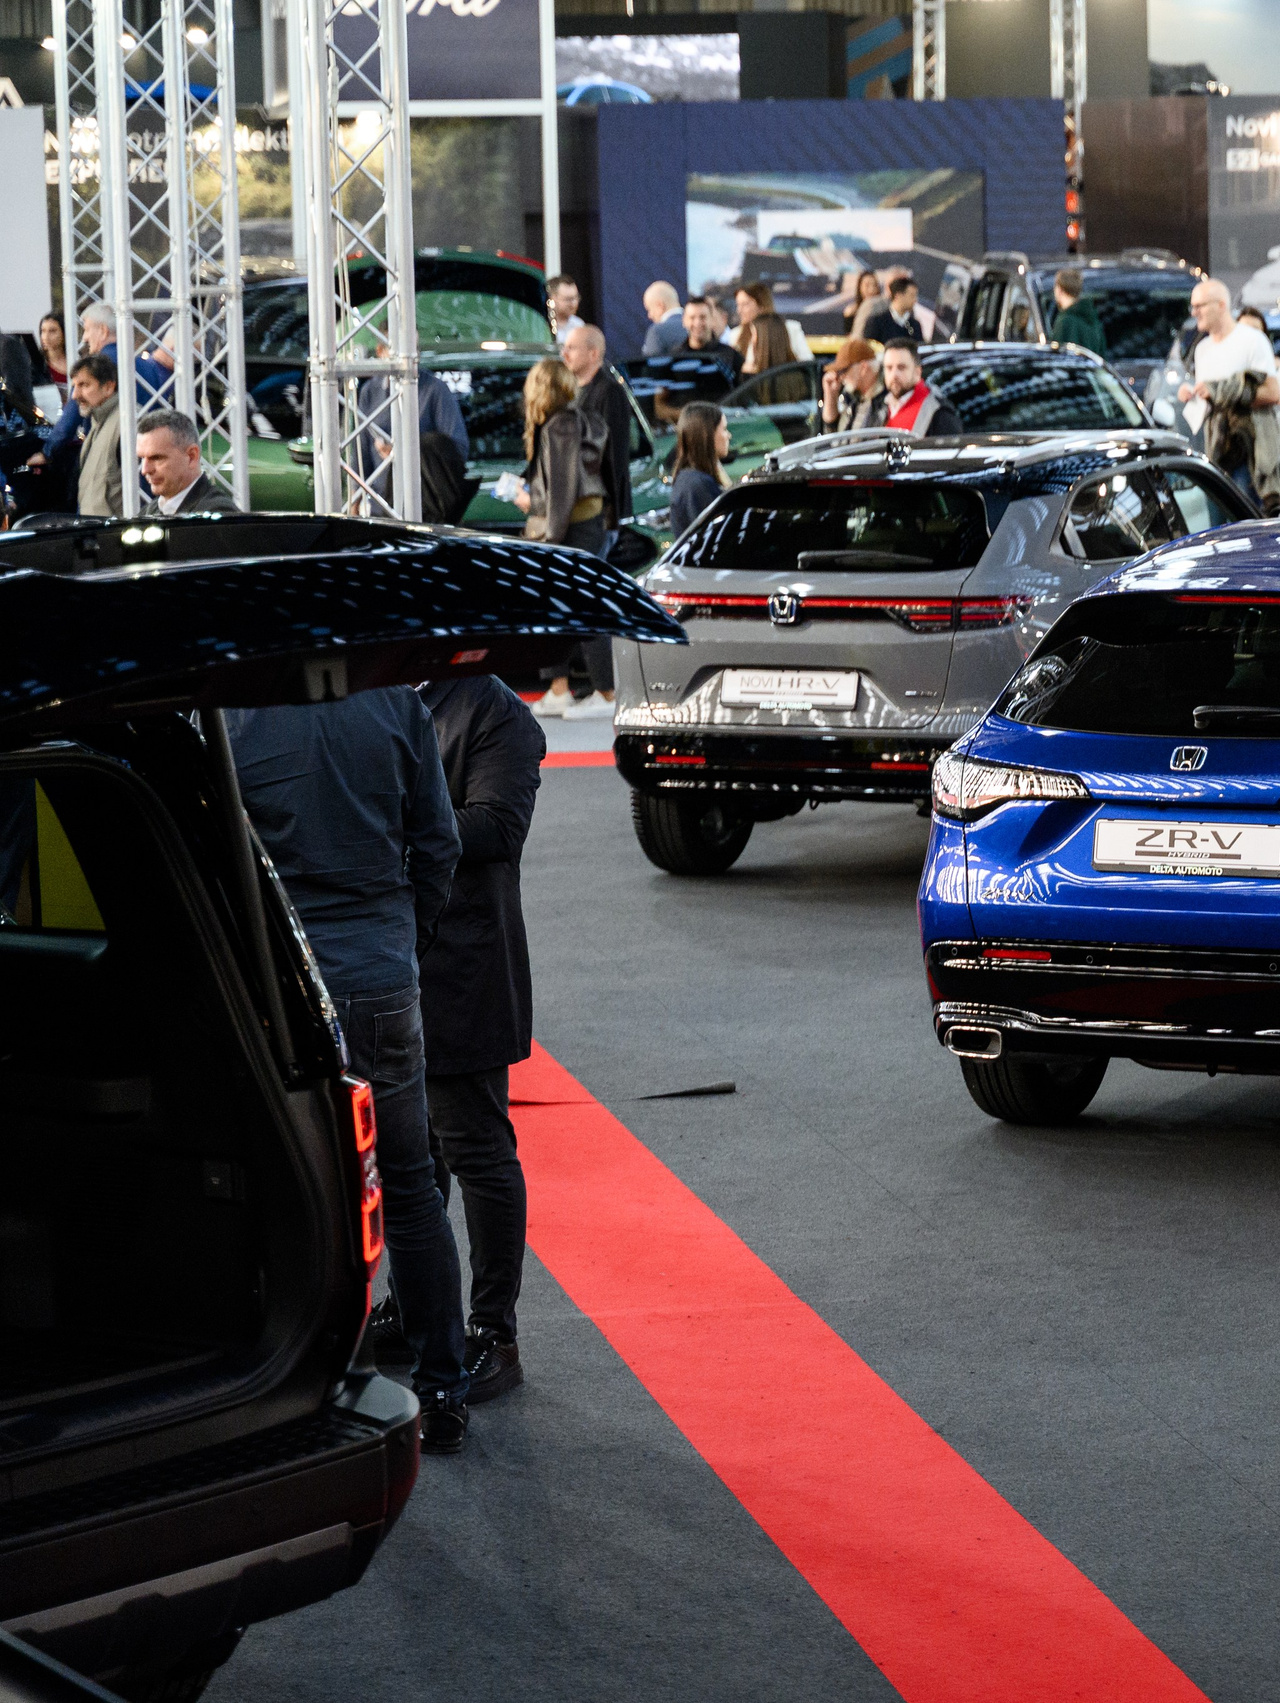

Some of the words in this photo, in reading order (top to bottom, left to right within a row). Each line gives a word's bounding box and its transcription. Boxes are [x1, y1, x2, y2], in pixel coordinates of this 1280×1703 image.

[1226, 112, 1278, 138] Novi
[740, 675, 774, 688] NOVI
[777, 676, 840, 689] HR-V
[1135, 827, 1243, 850] ZR-V
[1168, 851, 1211, 859] HYBRID
[1149, 864, 1174, 875] DELTA
[1175, 866, 1223, 877] AUTOMOTO
